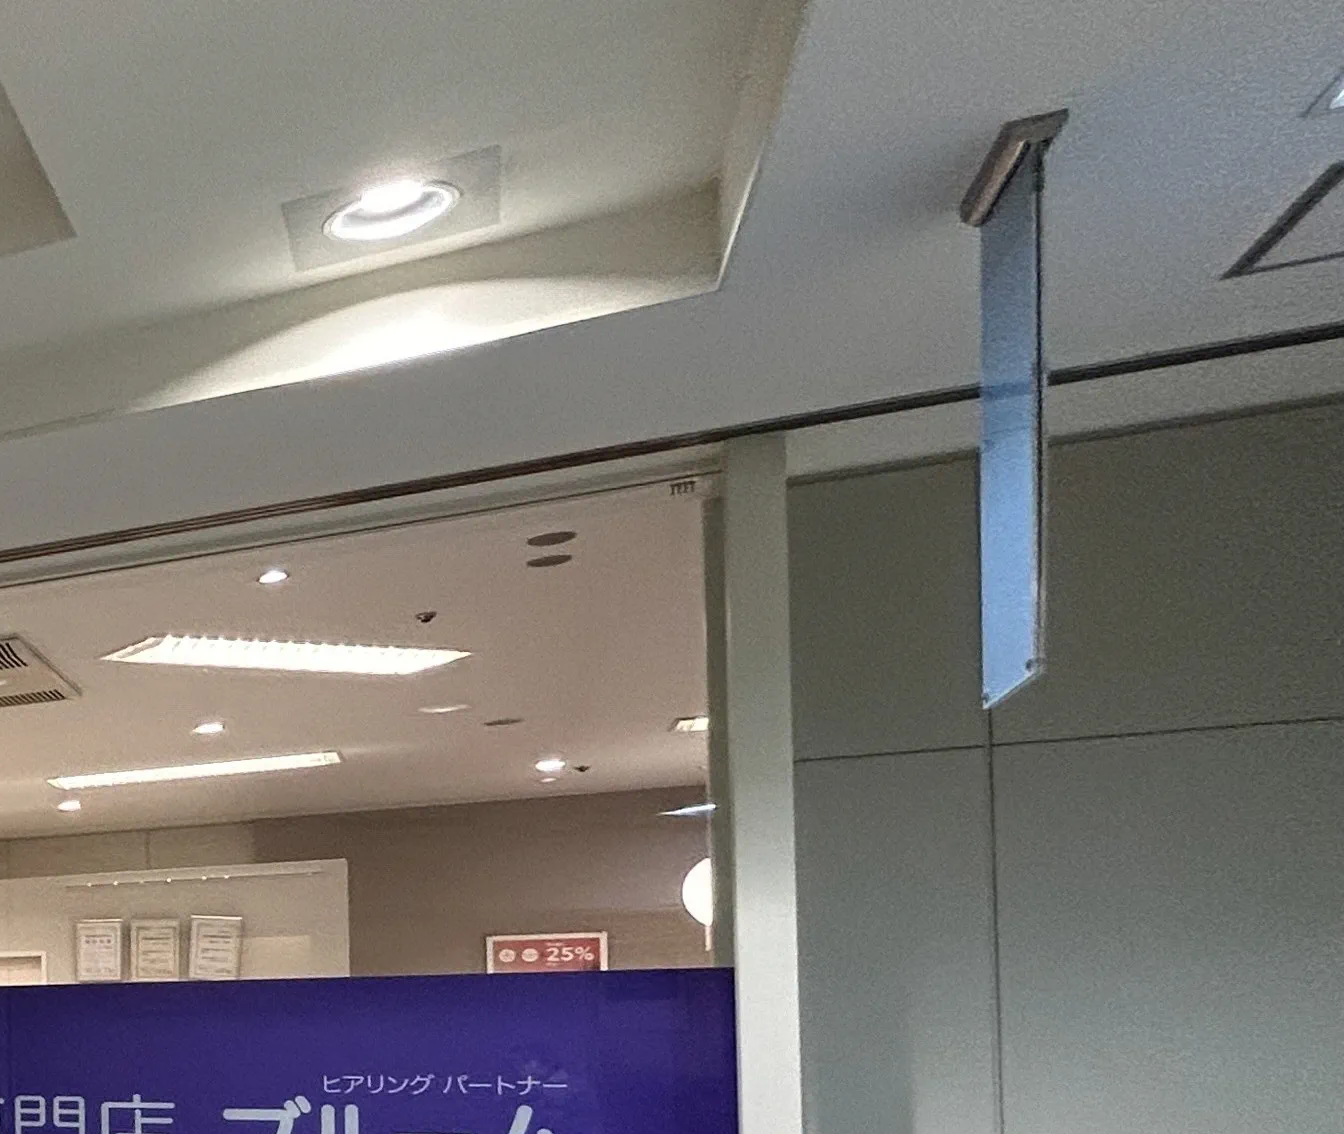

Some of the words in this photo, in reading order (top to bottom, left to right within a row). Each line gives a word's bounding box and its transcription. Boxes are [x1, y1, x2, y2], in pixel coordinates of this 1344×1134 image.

[546, 946, 595, 962] 25%
[322, 1074, 435, 1095] ヒアリング
[442, 1074, 568, 1096] パートナー
